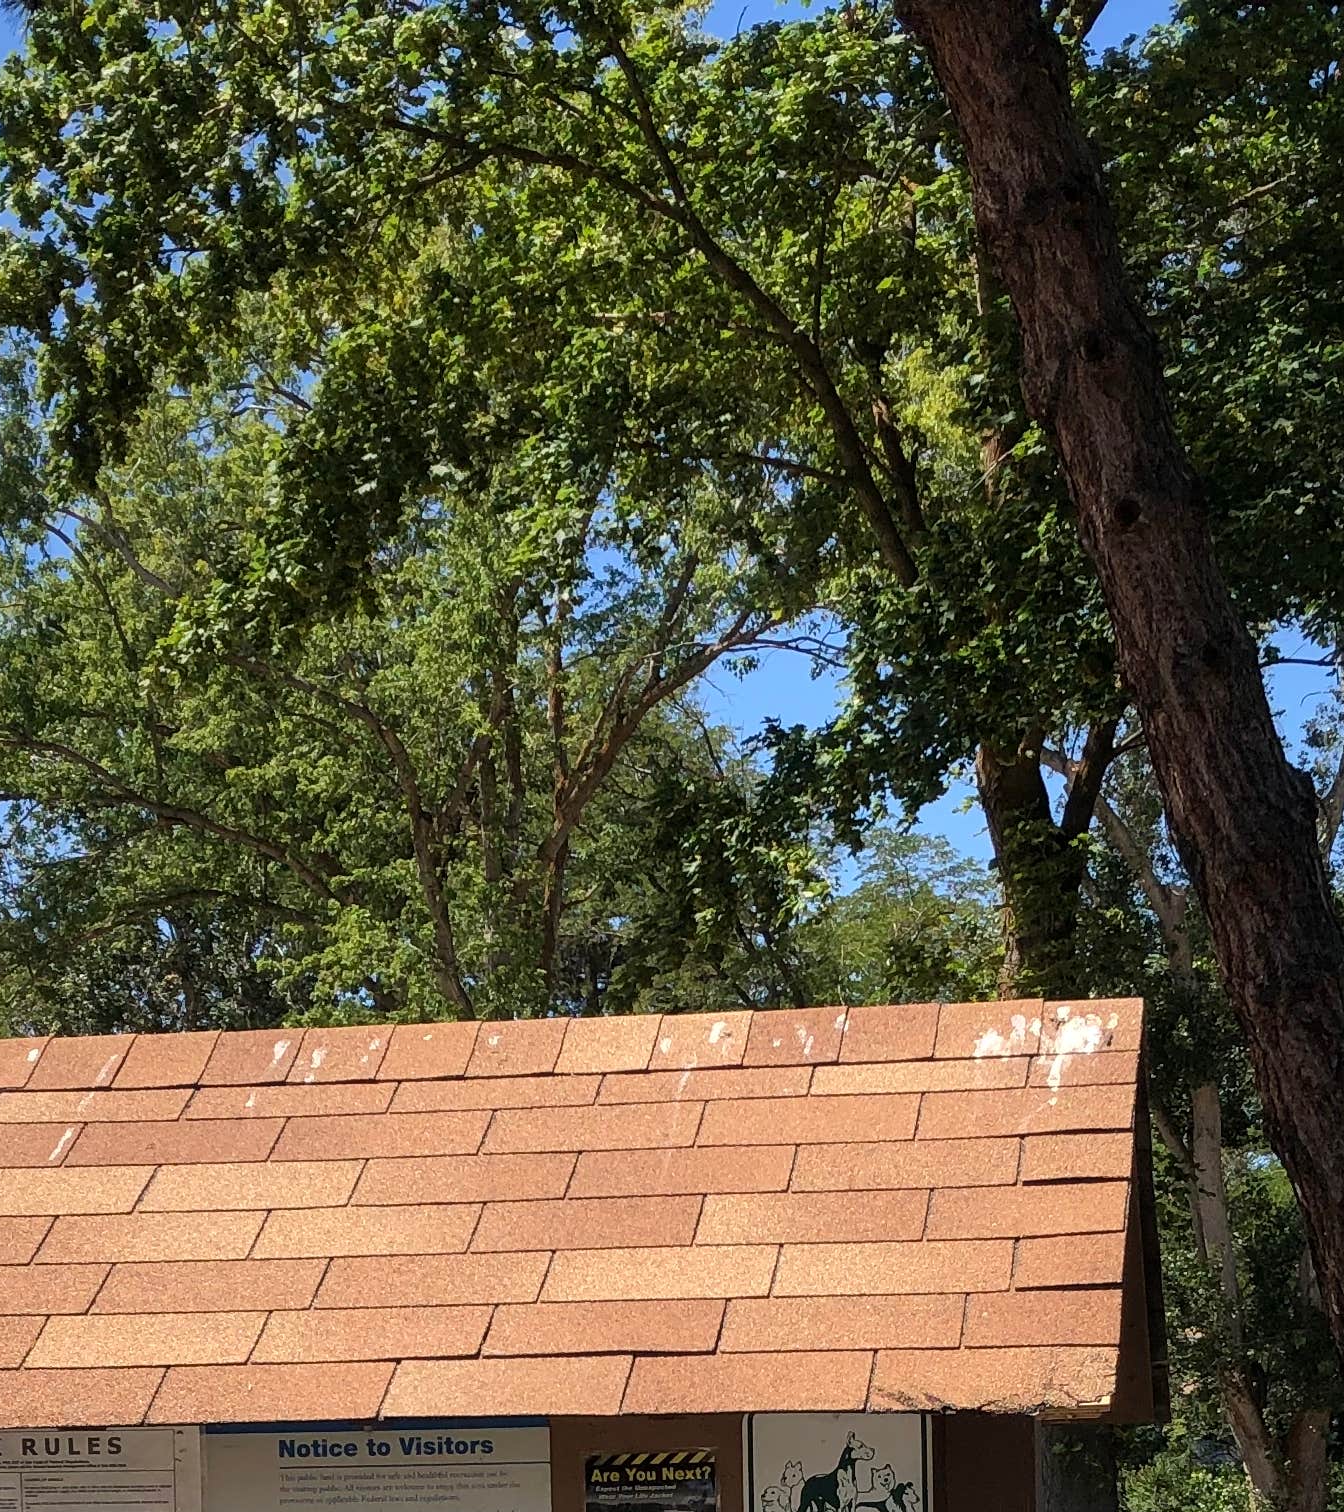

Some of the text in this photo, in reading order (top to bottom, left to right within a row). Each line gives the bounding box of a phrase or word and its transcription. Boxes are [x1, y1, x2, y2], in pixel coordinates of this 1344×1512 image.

[22, 1437, 122, 1456] RULES
[278, 1436, 494, 1458] Notice to Visitors
[591, 1466, 711, 1482] Are You Next?
